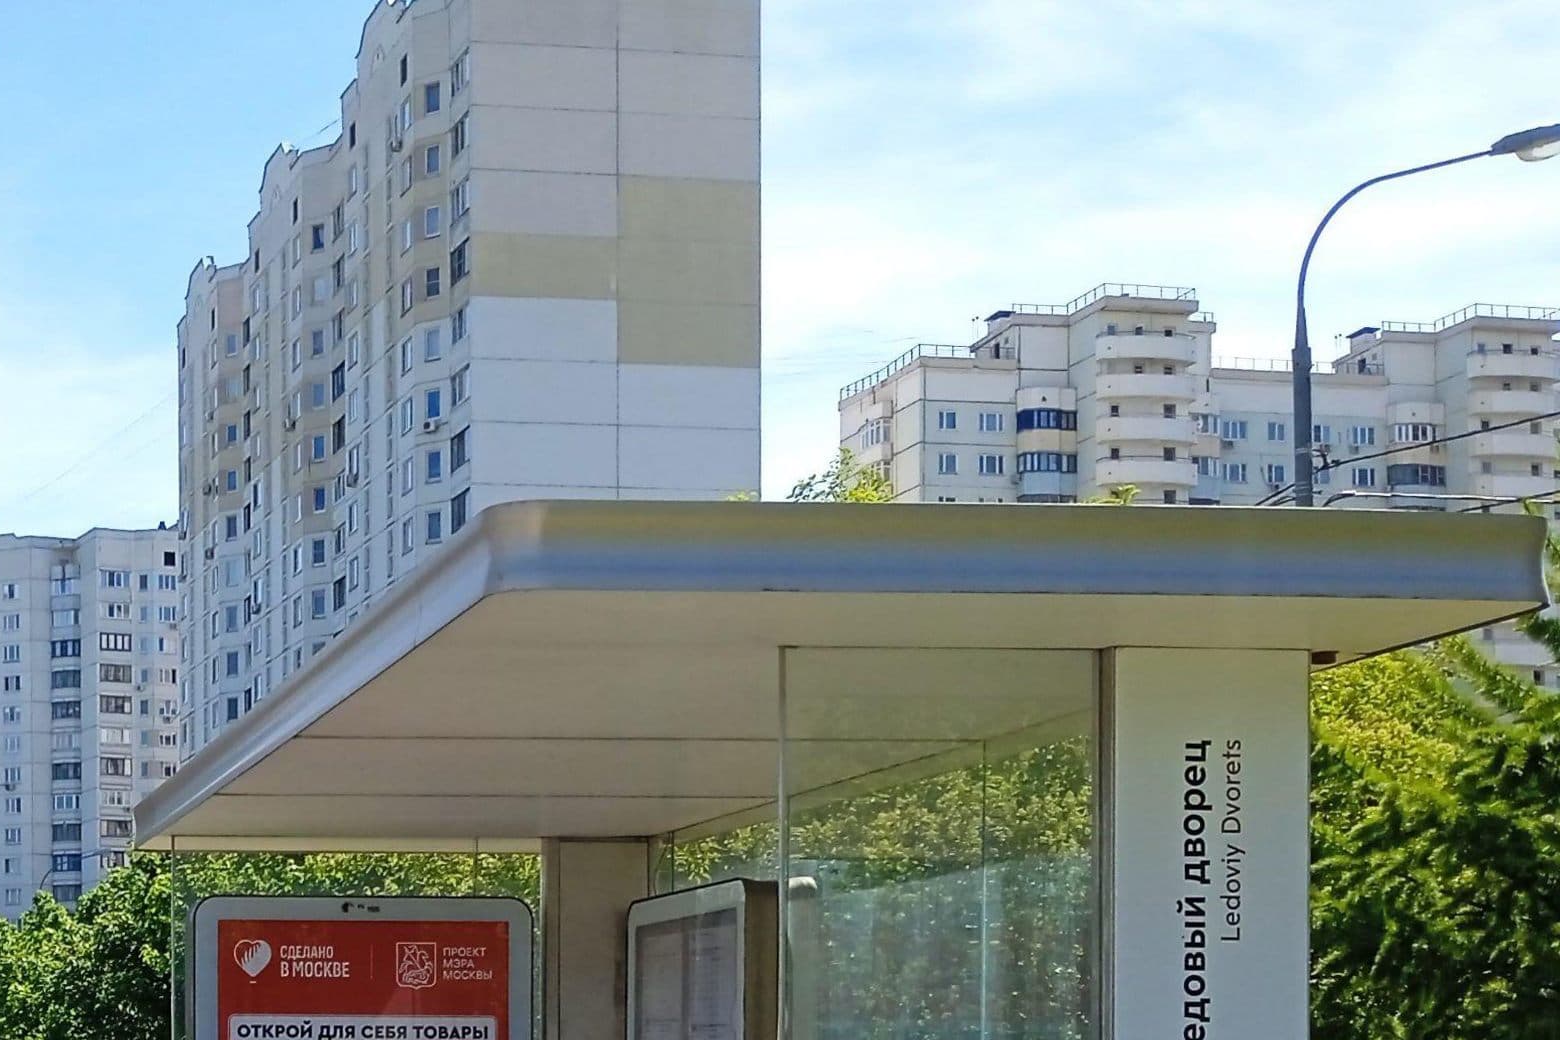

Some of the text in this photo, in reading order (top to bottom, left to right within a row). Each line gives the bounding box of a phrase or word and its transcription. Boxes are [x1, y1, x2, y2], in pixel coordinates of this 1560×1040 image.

[1183, 740, 1213, 884] дворец
[1220, 739, 1246, 942] Ledoviy Dvorets
[280, 945, 334, 960] СДЕЛАНО
[442, 947, 487, 957] ПРОЕКТ
[280, 962, 350, 978] В МОСКВЕ
[442, 959, 475, 969] МЭРА
[442, 970, 493, 980] МОСКВЫ
[237, 1020, 489, 1040] ОТКРОЙ ДЛЯ СЕБЯ ТОВАРЫ
